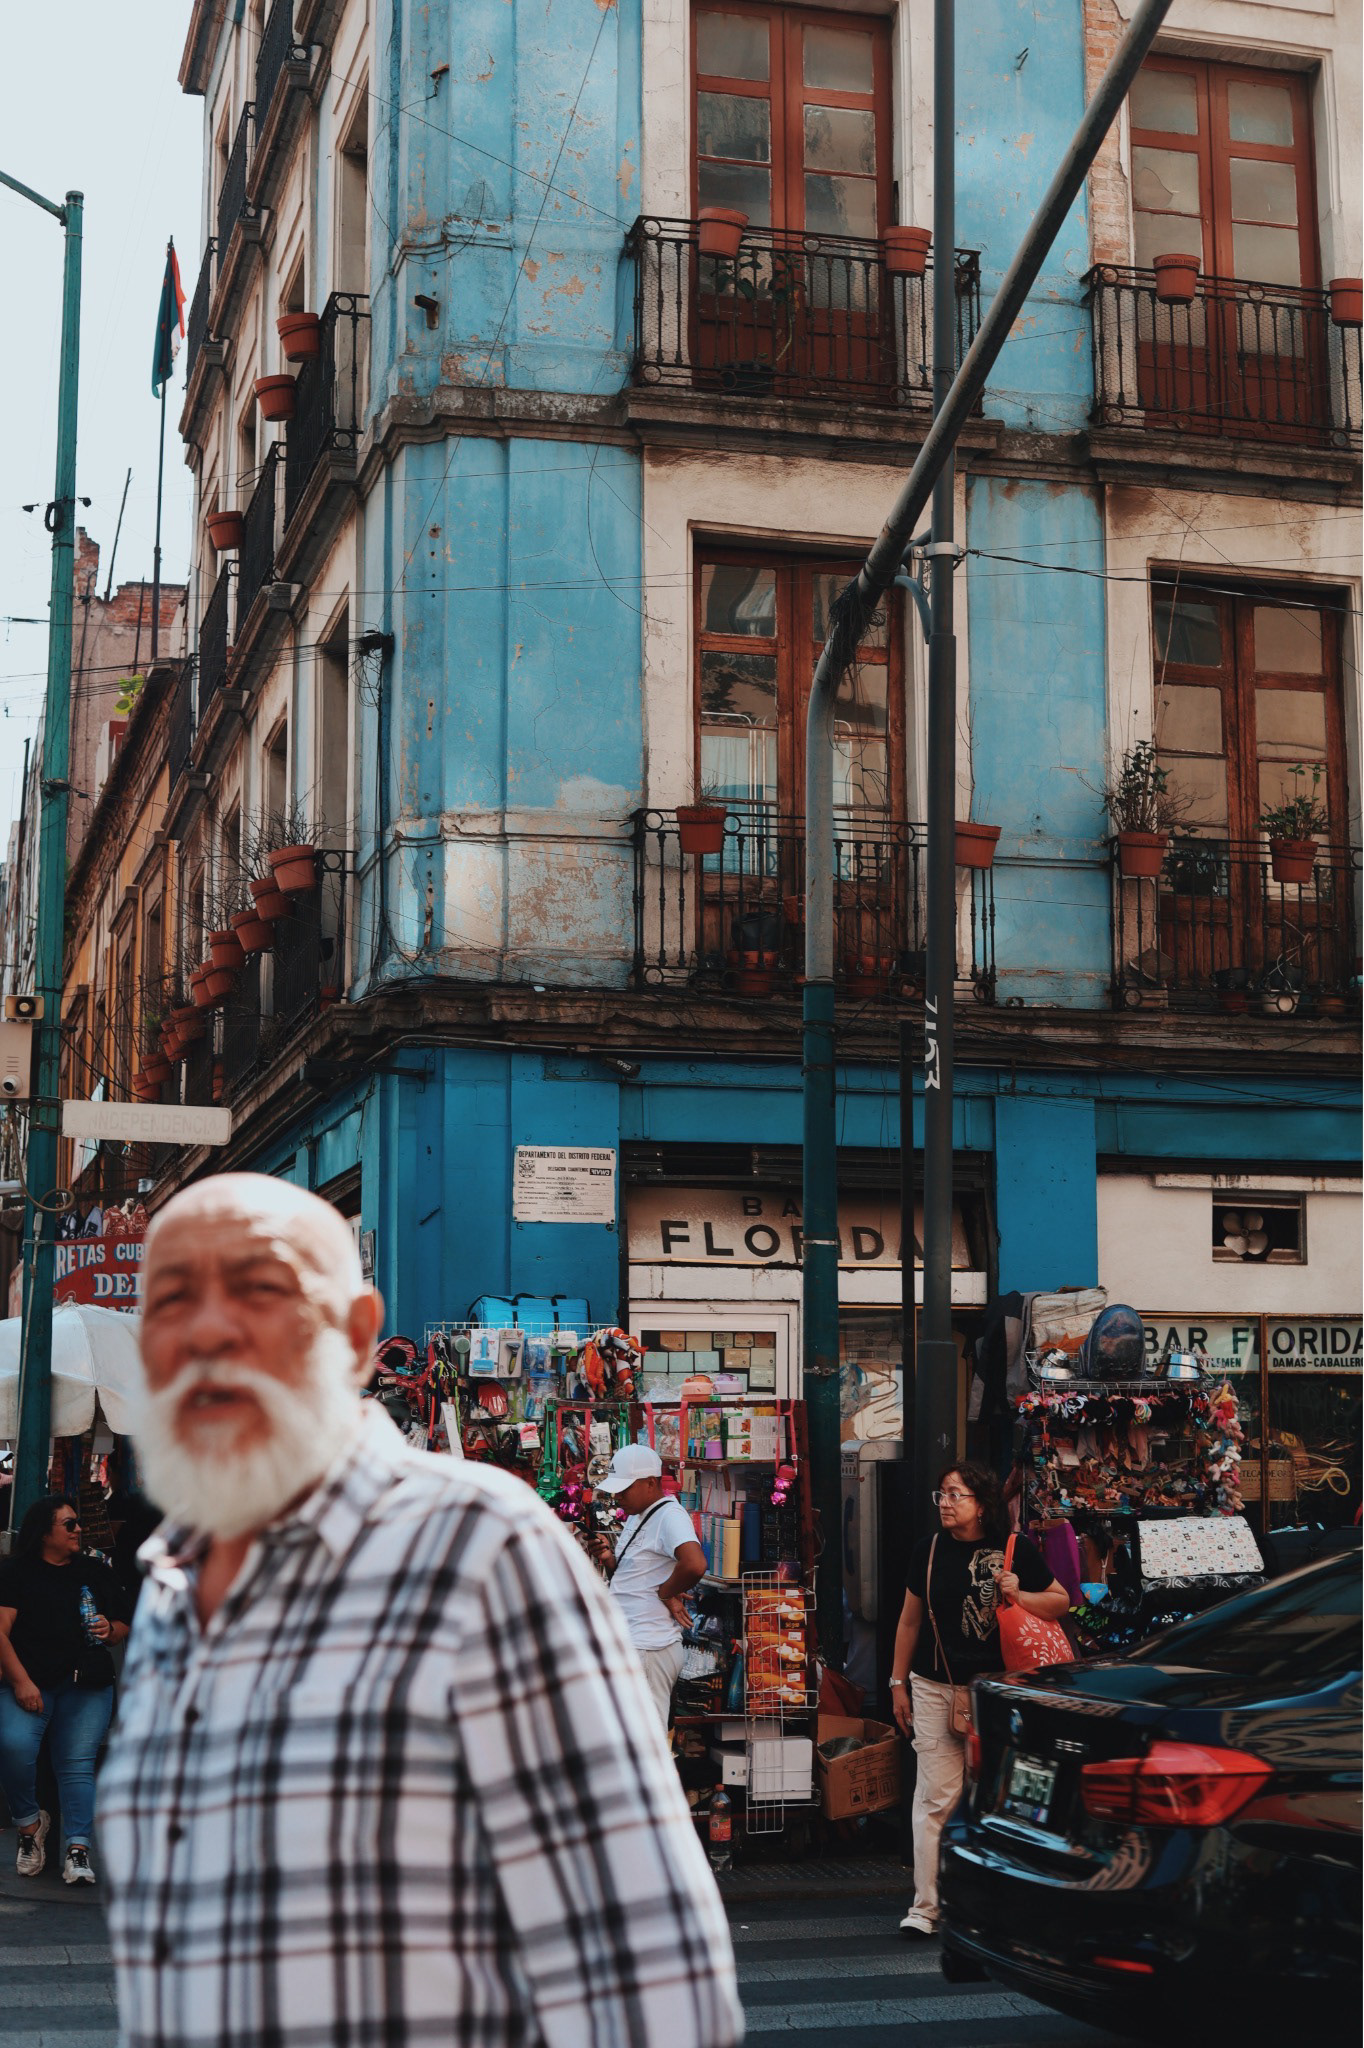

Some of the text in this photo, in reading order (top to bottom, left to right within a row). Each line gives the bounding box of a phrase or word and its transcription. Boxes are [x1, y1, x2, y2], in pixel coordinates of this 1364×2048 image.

[519, 1151, 556, 1159] DEPARTAMENTO
[558, 1152, 566, 1160] DEL
[568, 1152, 590, 1160] DISTRITO
[742, 1196, 804, 1218] BA
[53, 1242, 145, 1282] RETAS CUB
[1144, 1326, 1209, 1354] BAR
[1272, 1357, 1363, 1368] DAMAS-CABALLER
